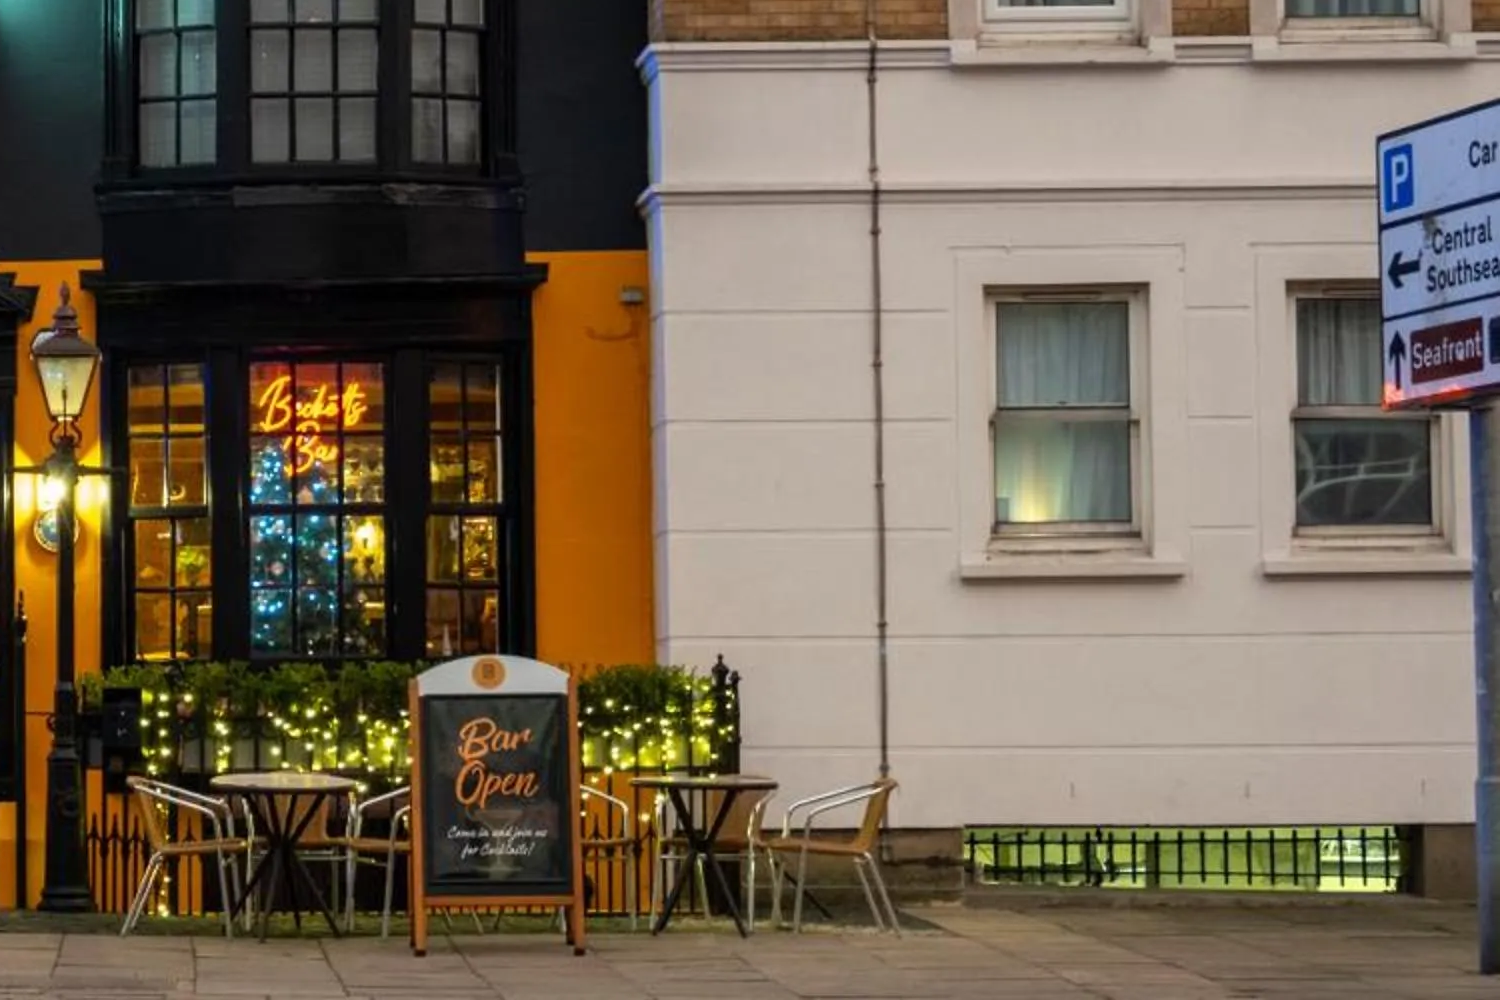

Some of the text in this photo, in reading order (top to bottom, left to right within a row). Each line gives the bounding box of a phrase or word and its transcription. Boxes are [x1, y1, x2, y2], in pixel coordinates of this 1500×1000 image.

[1468, 140, 1498, 168] Car
[1391, 153, 1409, 203] P
[1432, 215, 1493, 255] Central
[1426, 255, 1500, 293] Southsea
[1412, 331, 1482, 369] Seafront
[457, 716, 533, 760] Bar
[455, 759, 539, 810] Open
[447, 825, 477, 839] Come
[461, 844, 480, 860] for
